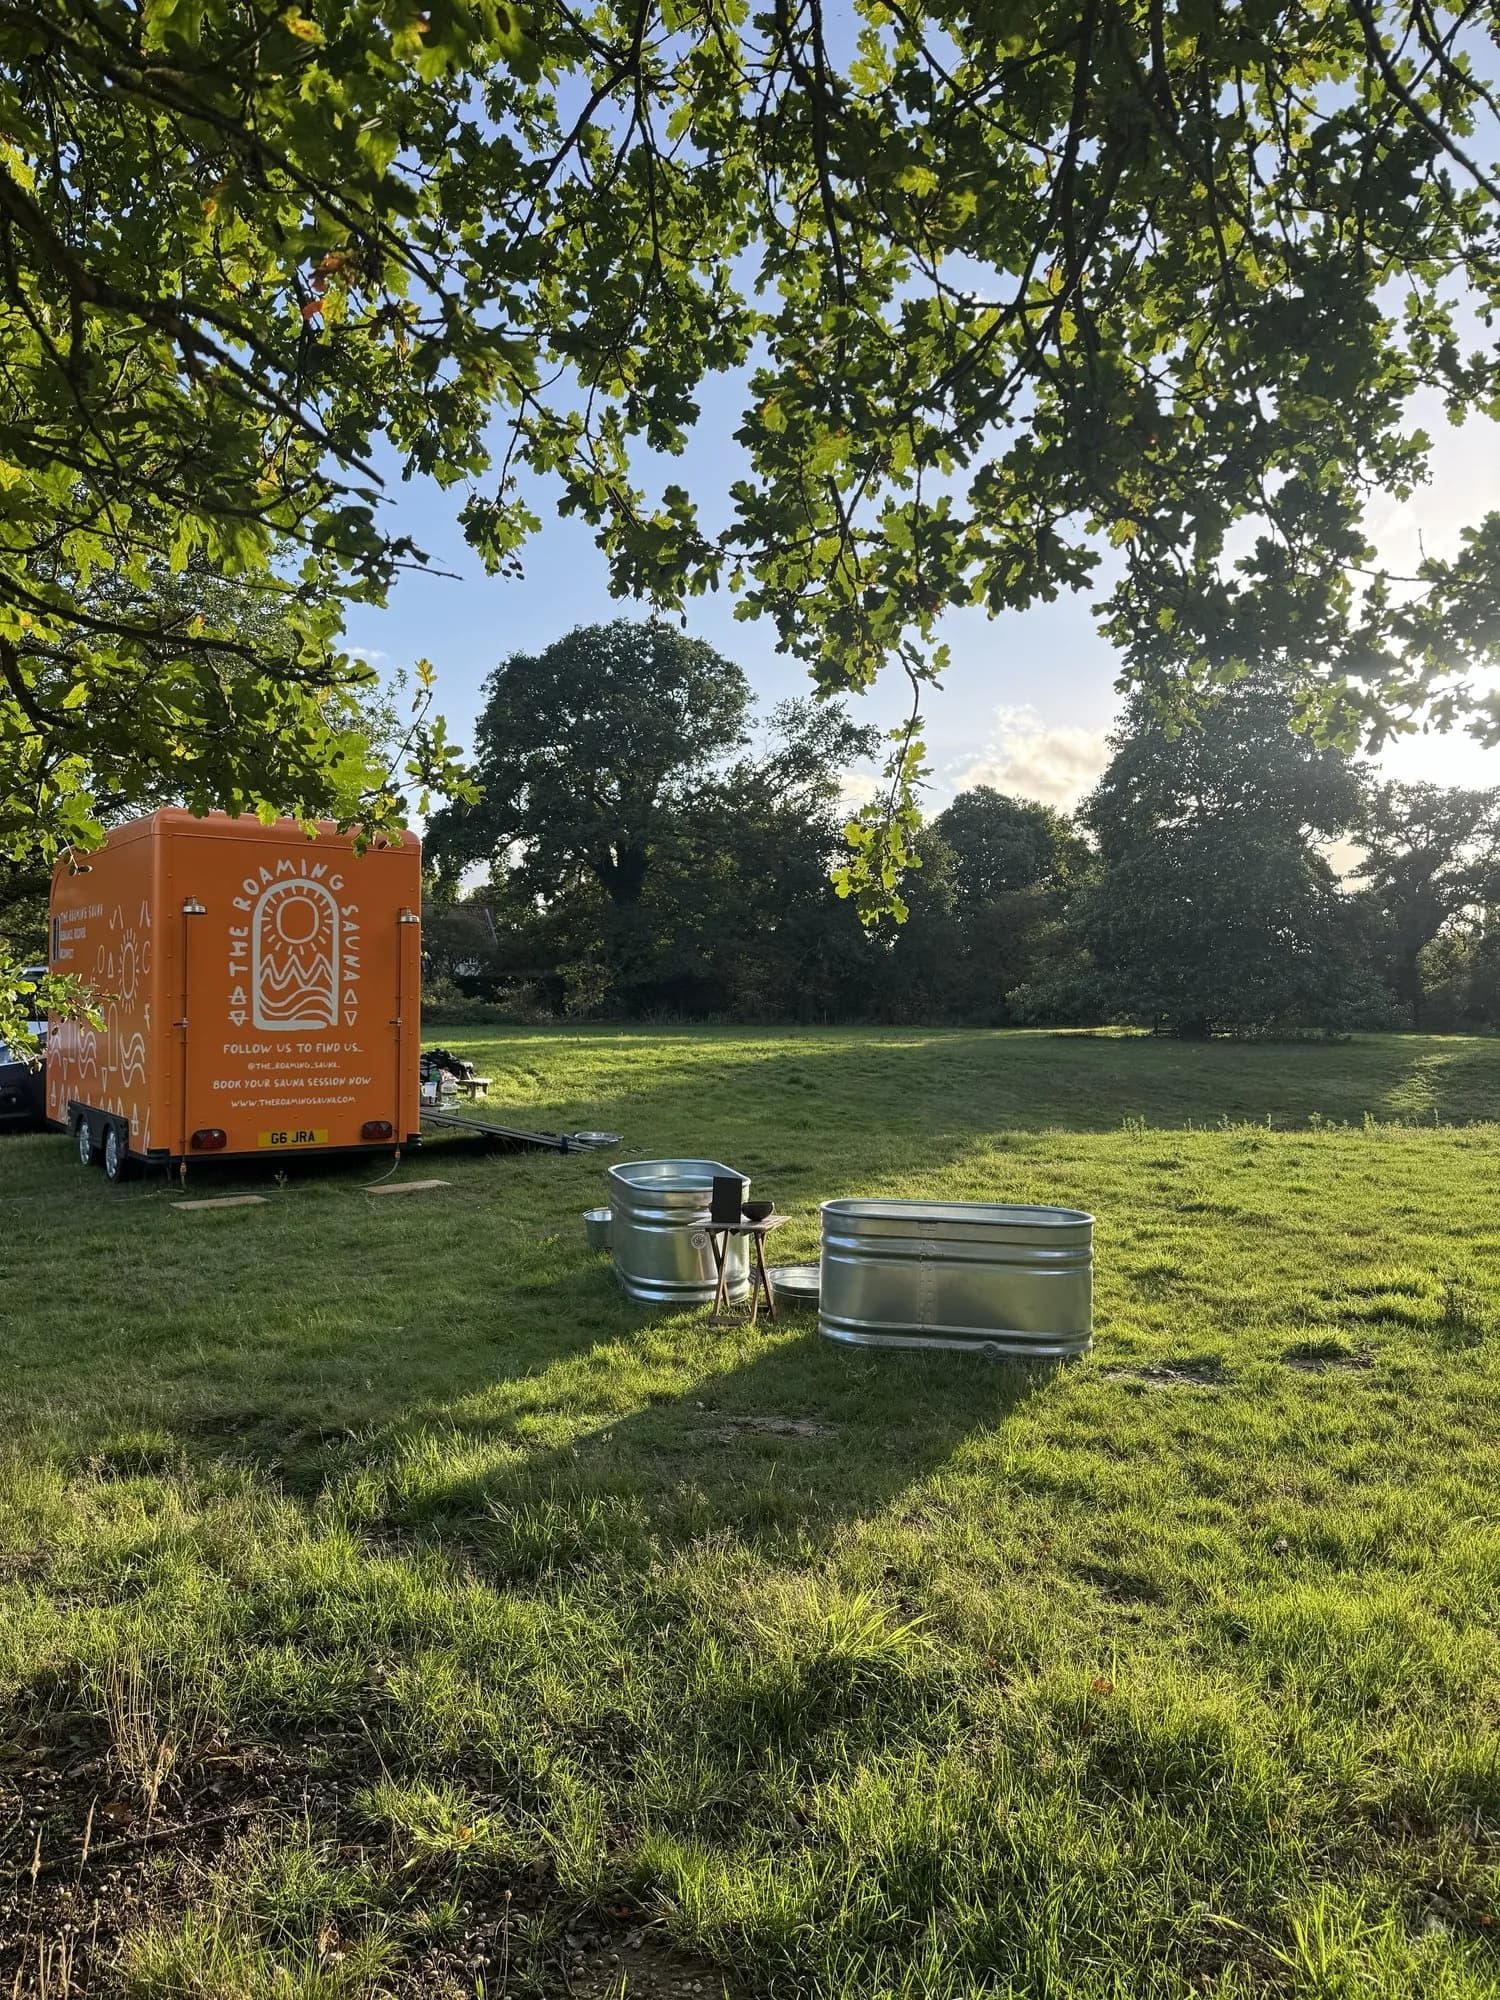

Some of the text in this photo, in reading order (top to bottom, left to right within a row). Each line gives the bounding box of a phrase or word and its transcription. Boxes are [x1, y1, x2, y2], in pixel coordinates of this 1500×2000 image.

[229, 858, 361, 981] THE ROAMING SAUNA
[223, 1044, 272, 1054] FOLLOW
[276, 1043, 292, 1053] US
[296, 1043, 312, 1053] TO
[316, 1042, 341, 1053] FIND
[213, 1076, 372, 1089] BOOK YOUR SAUNA SESSION NOW
[271, 1130, 315, 1144] G6 JRA
